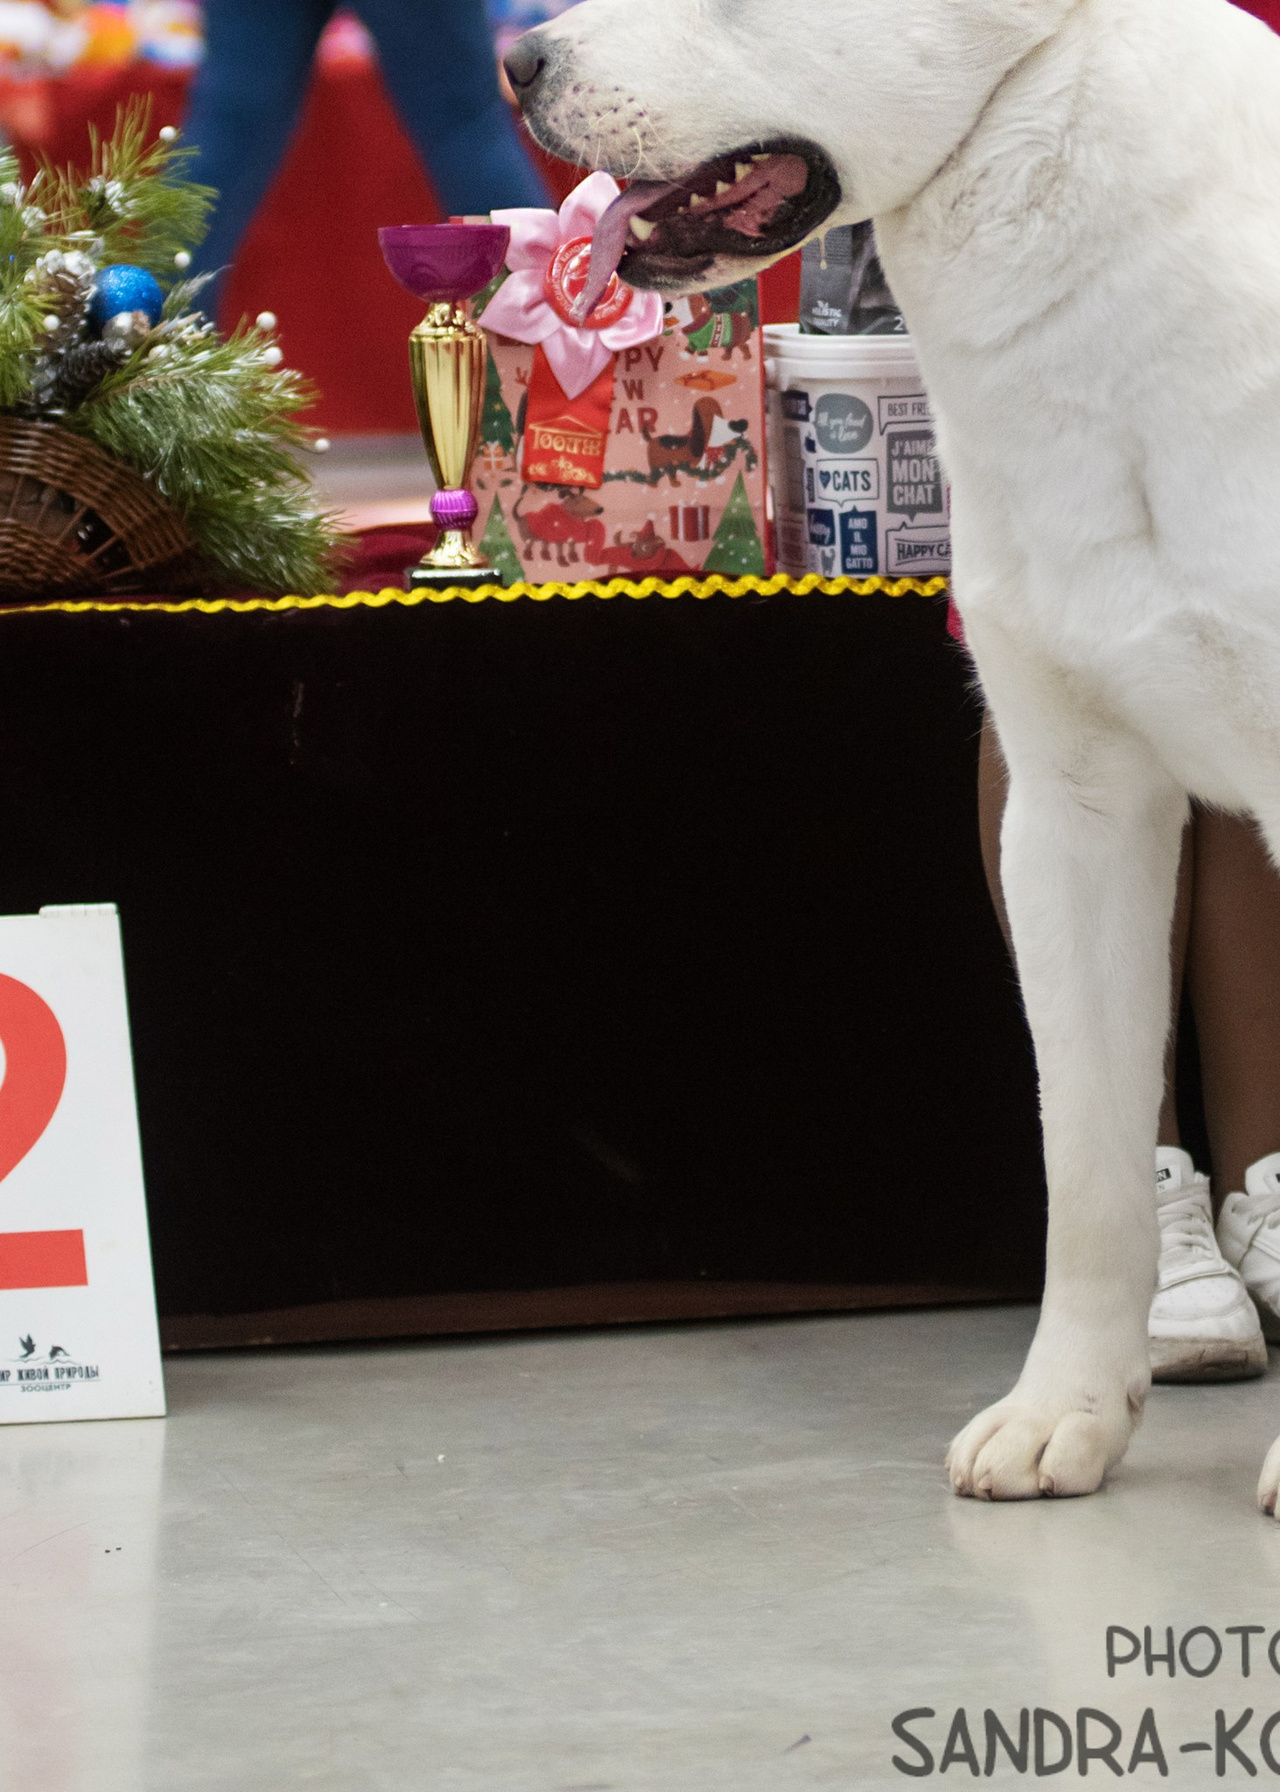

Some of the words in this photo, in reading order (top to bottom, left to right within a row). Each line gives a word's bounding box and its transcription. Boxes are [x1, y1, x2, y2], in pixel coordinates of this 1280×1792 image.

[888, 402, 909, 417] BEST
[892, 458, 936, 483] MON
[832, 470, 871, 492] CATS
[892, 484, 935, 506] CHAT
[848, 517, 868, 529] AMO
[850, 544, 868, 556] MIO
[897, 543, 936, 560] HAPPY
[937, 543, 951, 557] CA
[845, 557, 873, 569] GATTO
[0, 1369, 11, 1382] ИР
[55, 1366, 99, 1379] ПРИРОДЫ
[21, 1384, 71, 1392] ЗООЦЕНТР
